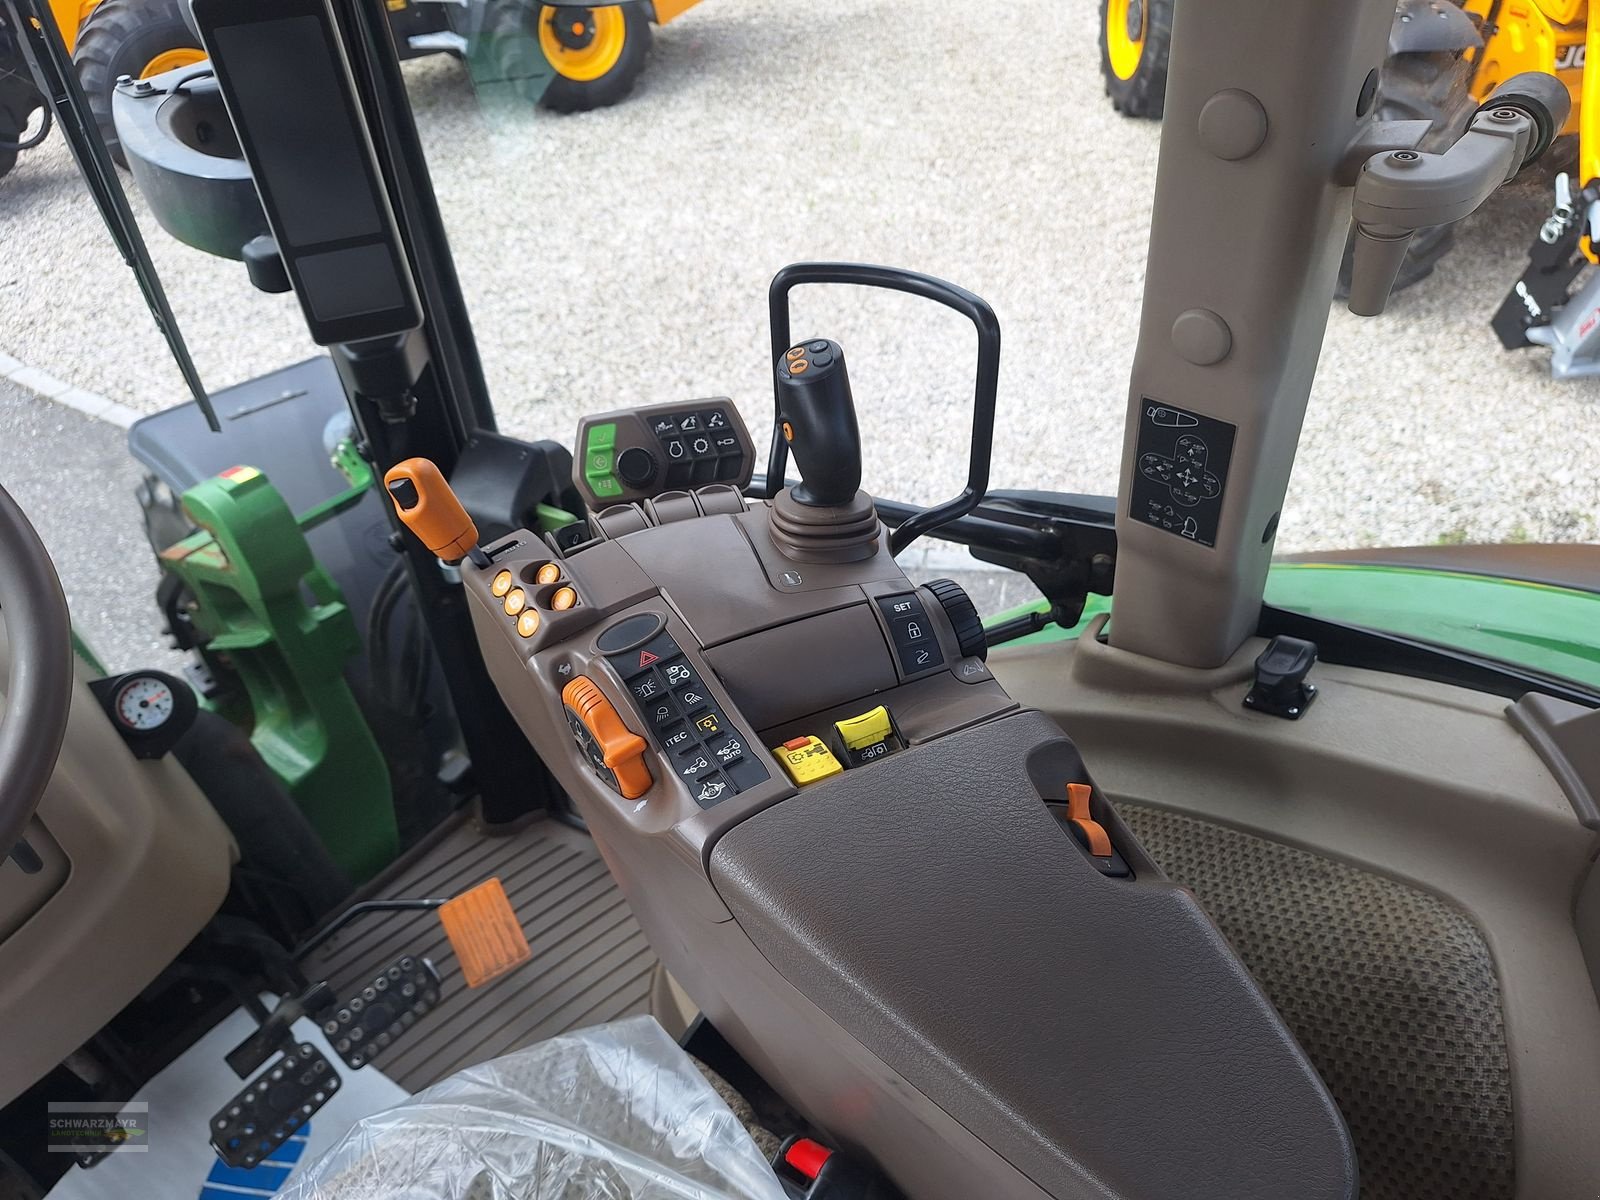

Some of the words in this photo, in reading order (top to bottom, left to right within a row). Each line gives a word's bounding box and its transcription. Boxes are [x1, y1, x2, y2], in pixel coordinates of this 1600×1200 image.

[504, 540, 528, 554] AUTO
[893, 602, 911, 612] SET
[723, 748, 742, 761] AUTO
